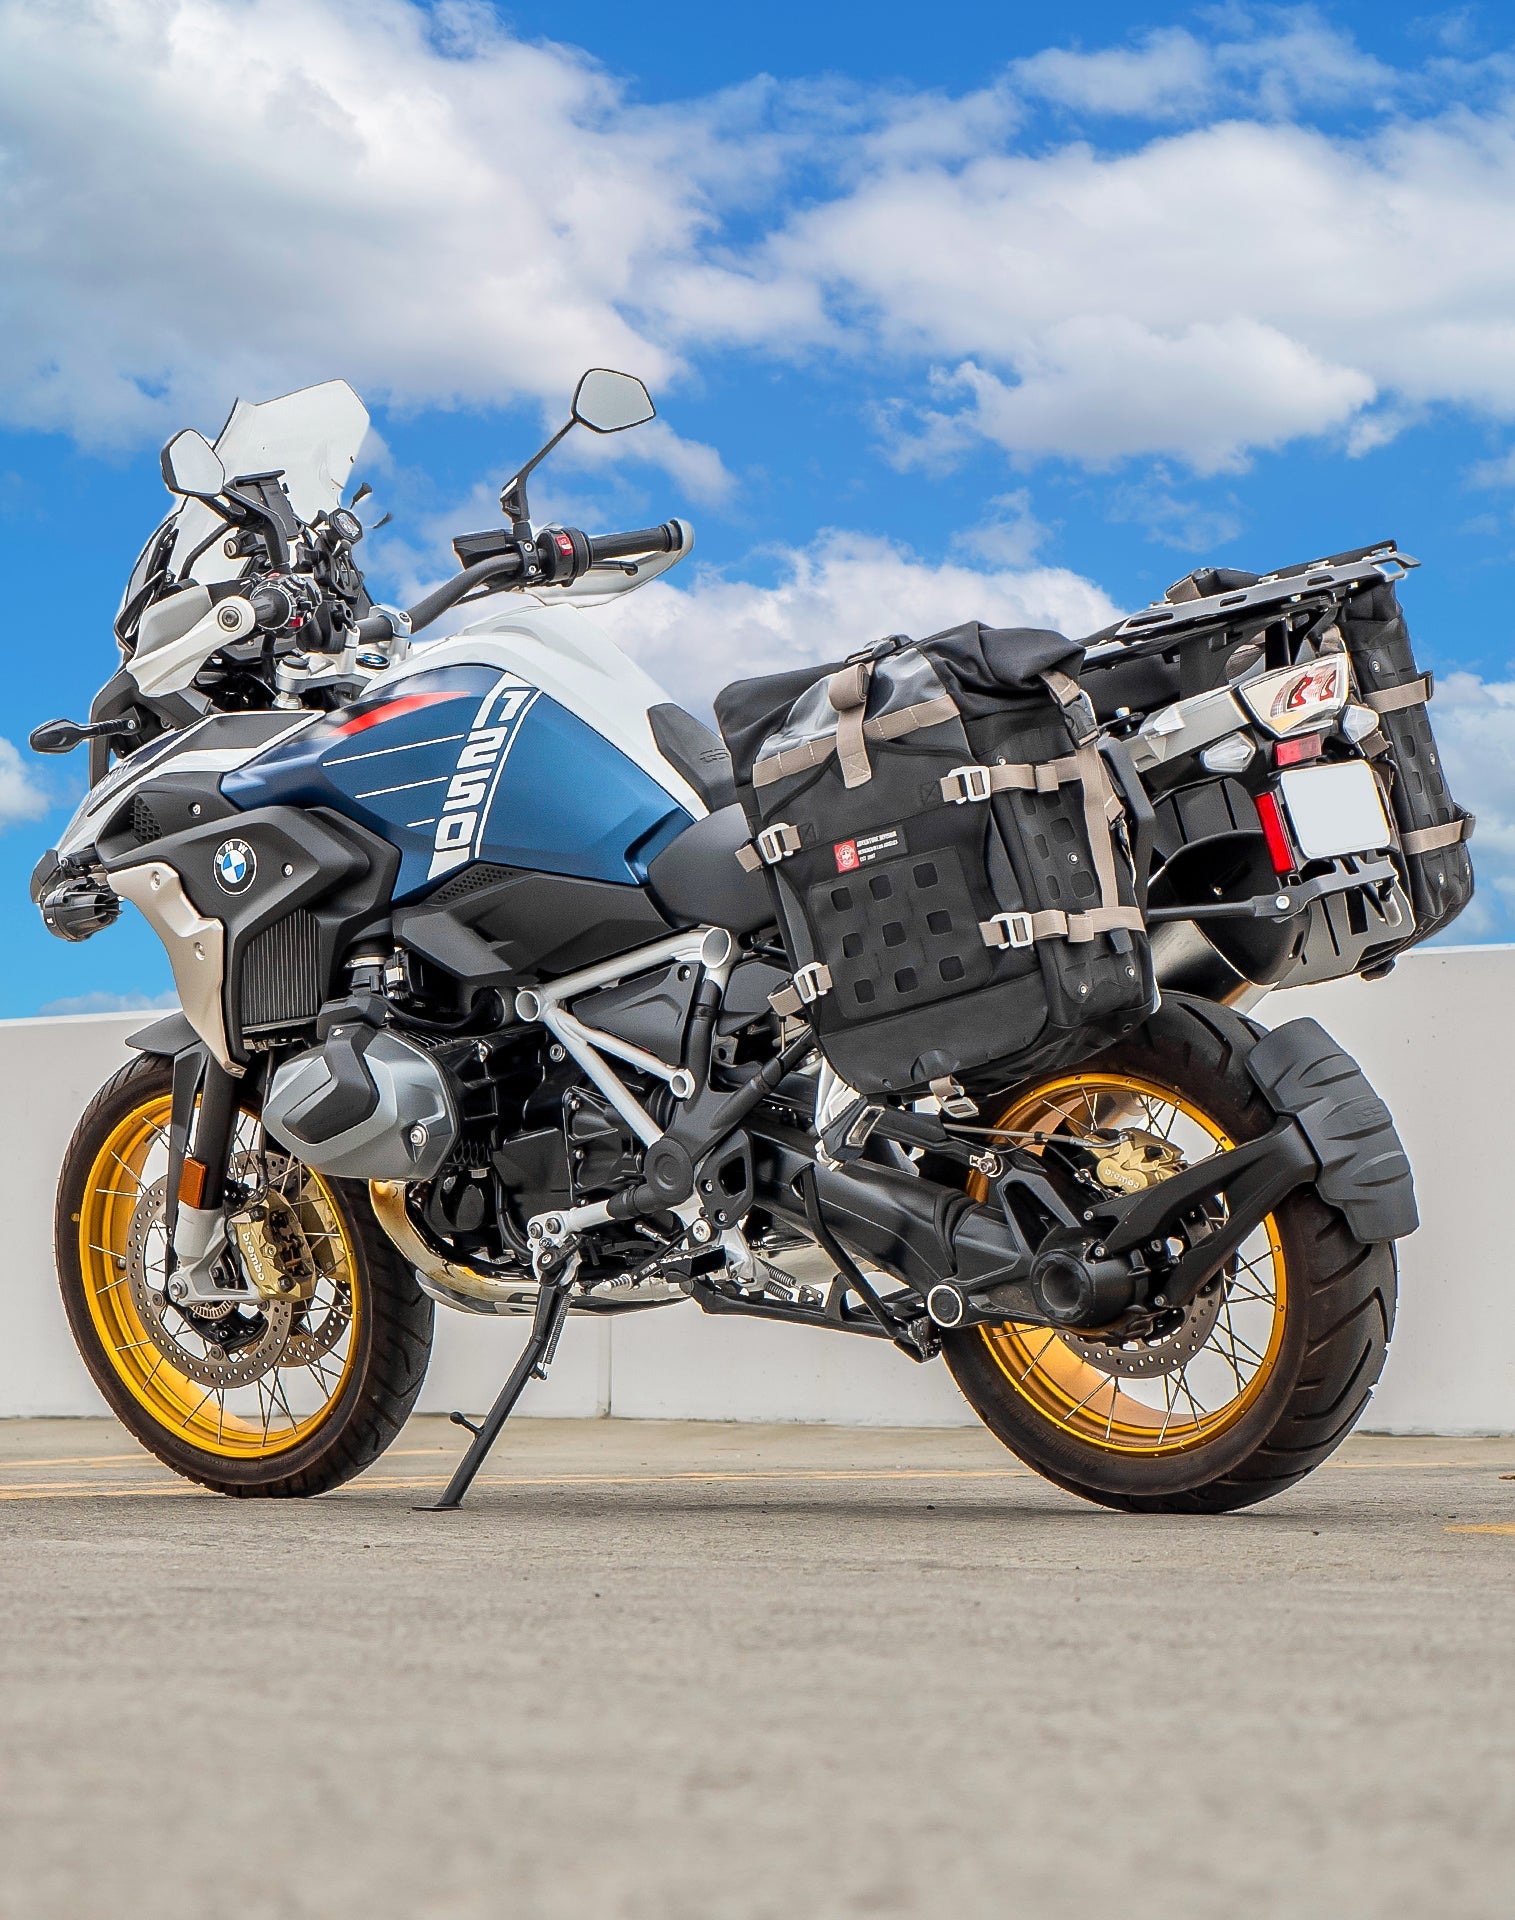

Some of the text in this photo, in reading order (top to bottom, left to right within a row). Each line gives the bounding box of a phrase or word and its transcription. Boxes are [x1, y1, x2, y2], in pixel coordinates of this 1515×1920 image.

[434, 690, 531, 850] 1250
[216, 841, 249, 865] BMW
[1104, 1165, 1141, 1189] brembo
[242, 1231, 265, 1281] brembo
